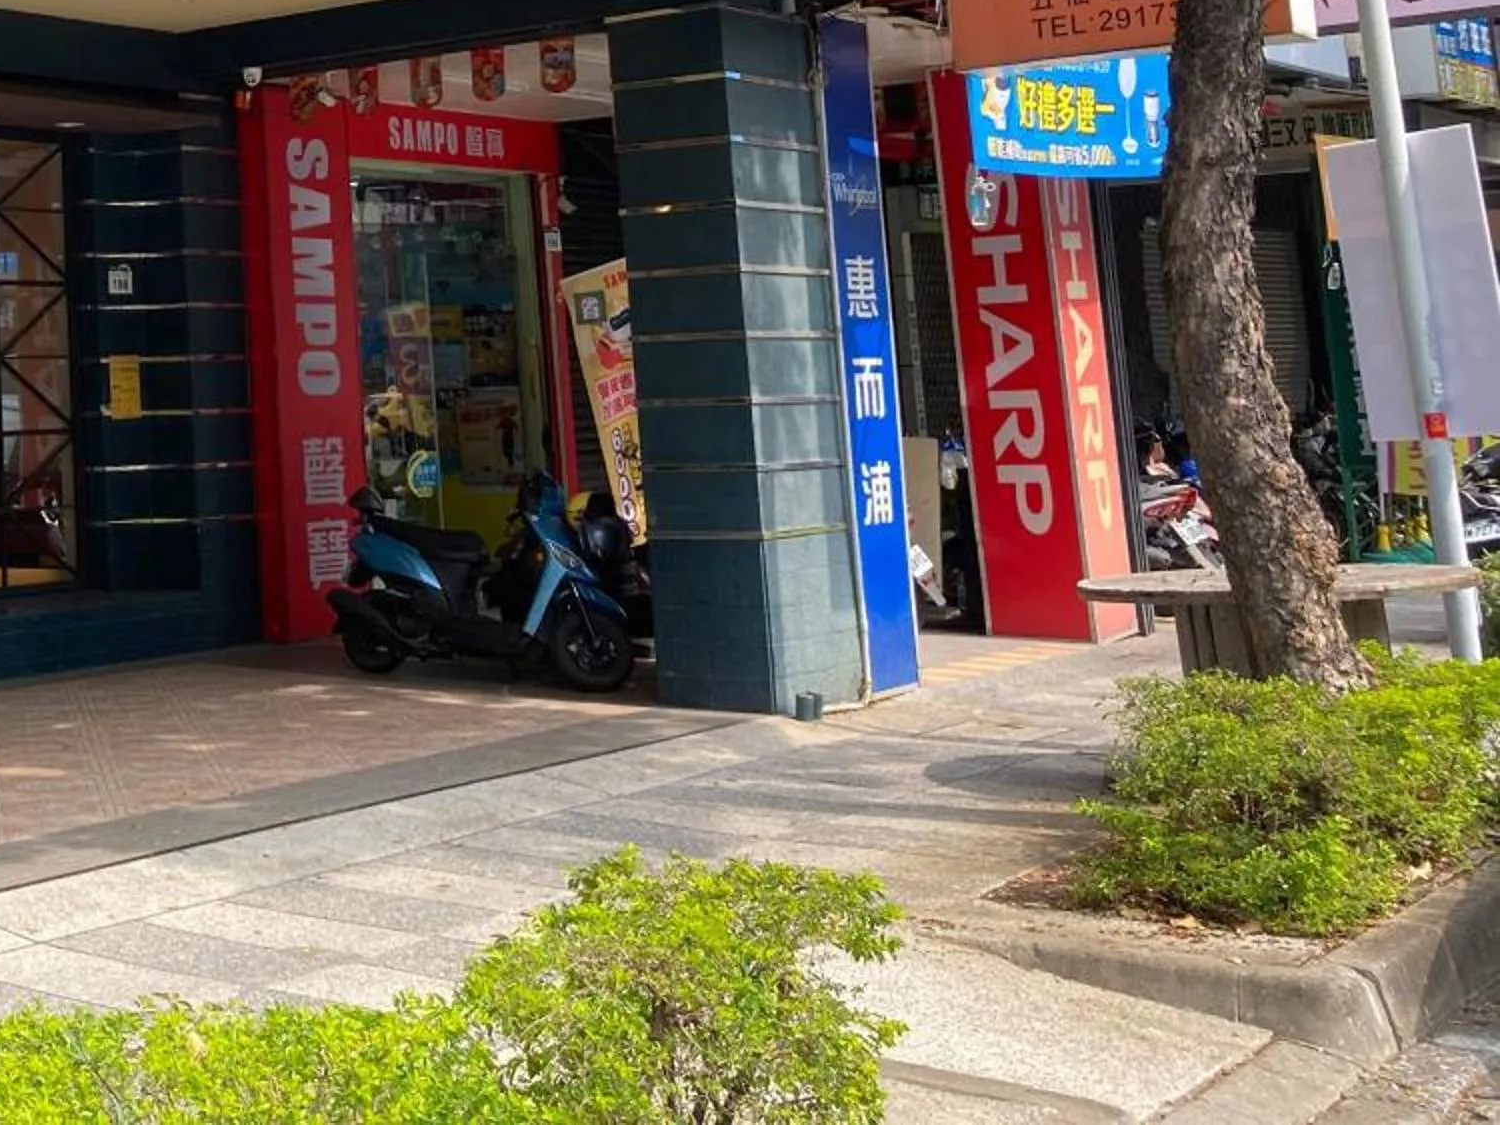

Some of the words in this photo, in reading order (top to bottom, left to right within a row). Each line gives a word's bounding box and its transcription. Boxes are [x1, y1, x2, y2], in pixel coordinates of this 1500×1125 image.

[387, 116, 459, 156] SAMPO
[286, 138, 341, 396] SAMPO
[845, 255, 894, 527] 惠而浦
[302, 436, 350, 589] 聲寶
